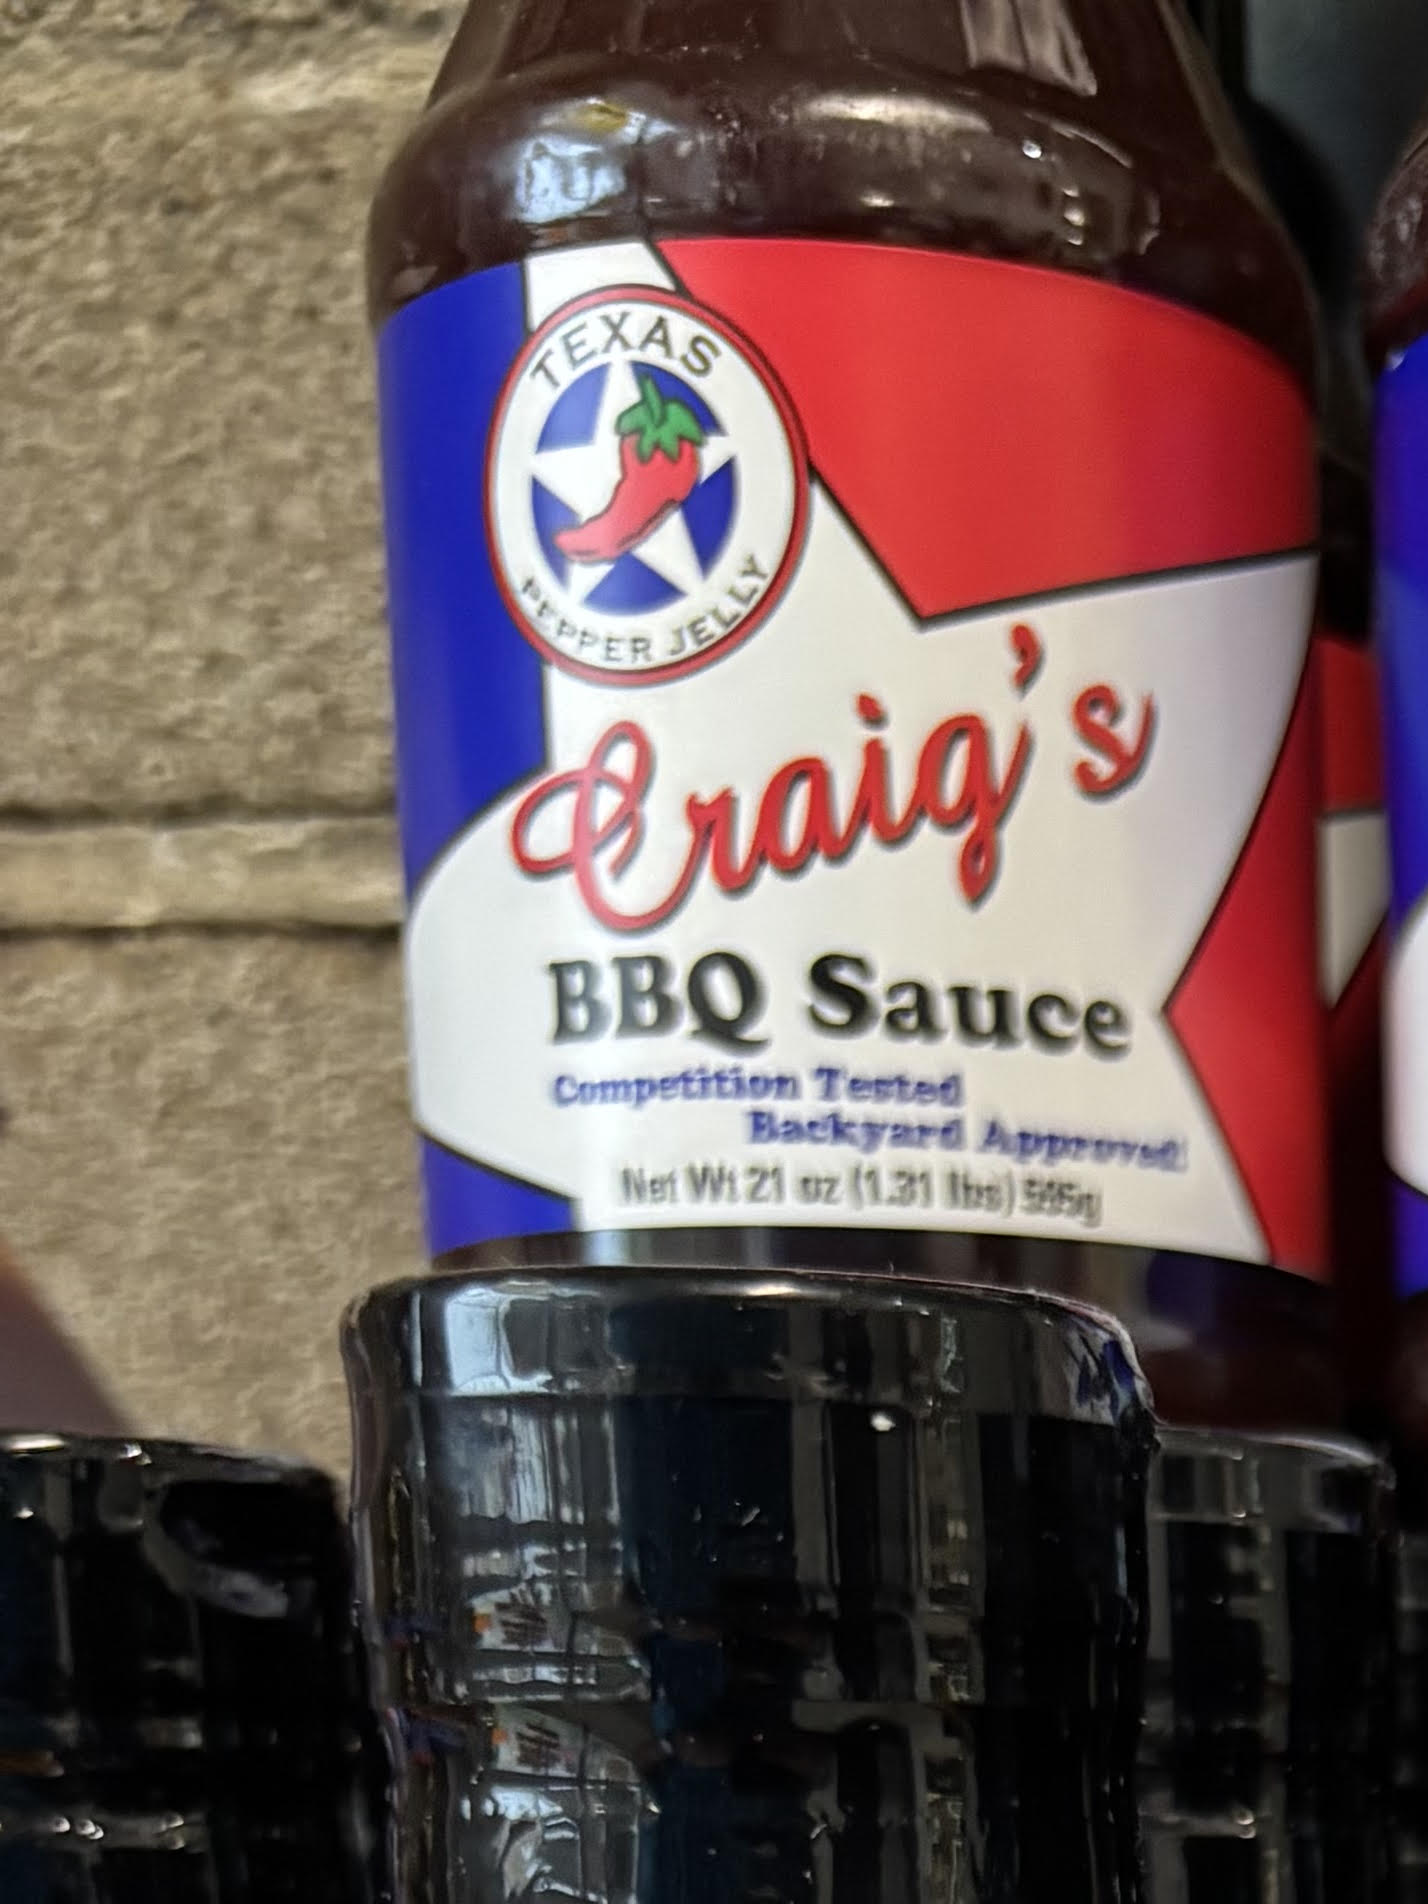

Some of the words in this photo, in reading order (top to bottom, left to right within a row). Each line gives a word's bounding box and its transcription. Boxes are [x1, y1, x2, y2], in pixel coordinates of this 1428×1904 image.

[529, 309, 721, 390] TEXAS
[519, 576, 653, 664] PEPPER
[667, 562, 769, 659] JELLY
[510, 623, 1158, 930] Craig's
[548, 952, 767, 1048] BBQ
[808, 953, 1132, 1054] Sauce
[553, 1067, 799, 1109] Competition
[815, 1068, 963, 1107] Tested
[747, 1111, 964, 1152] Backyard
[621, 1167, 679, 1203] Net
[685, 1167, 740, 1203] Wt
[748, 1168, 786, 1203] 21
[800, 1174, 842, 1204] oz
[852, 1169, 931, 1210] (1.31
[949, 1172, 1016, 1217] lbs)
